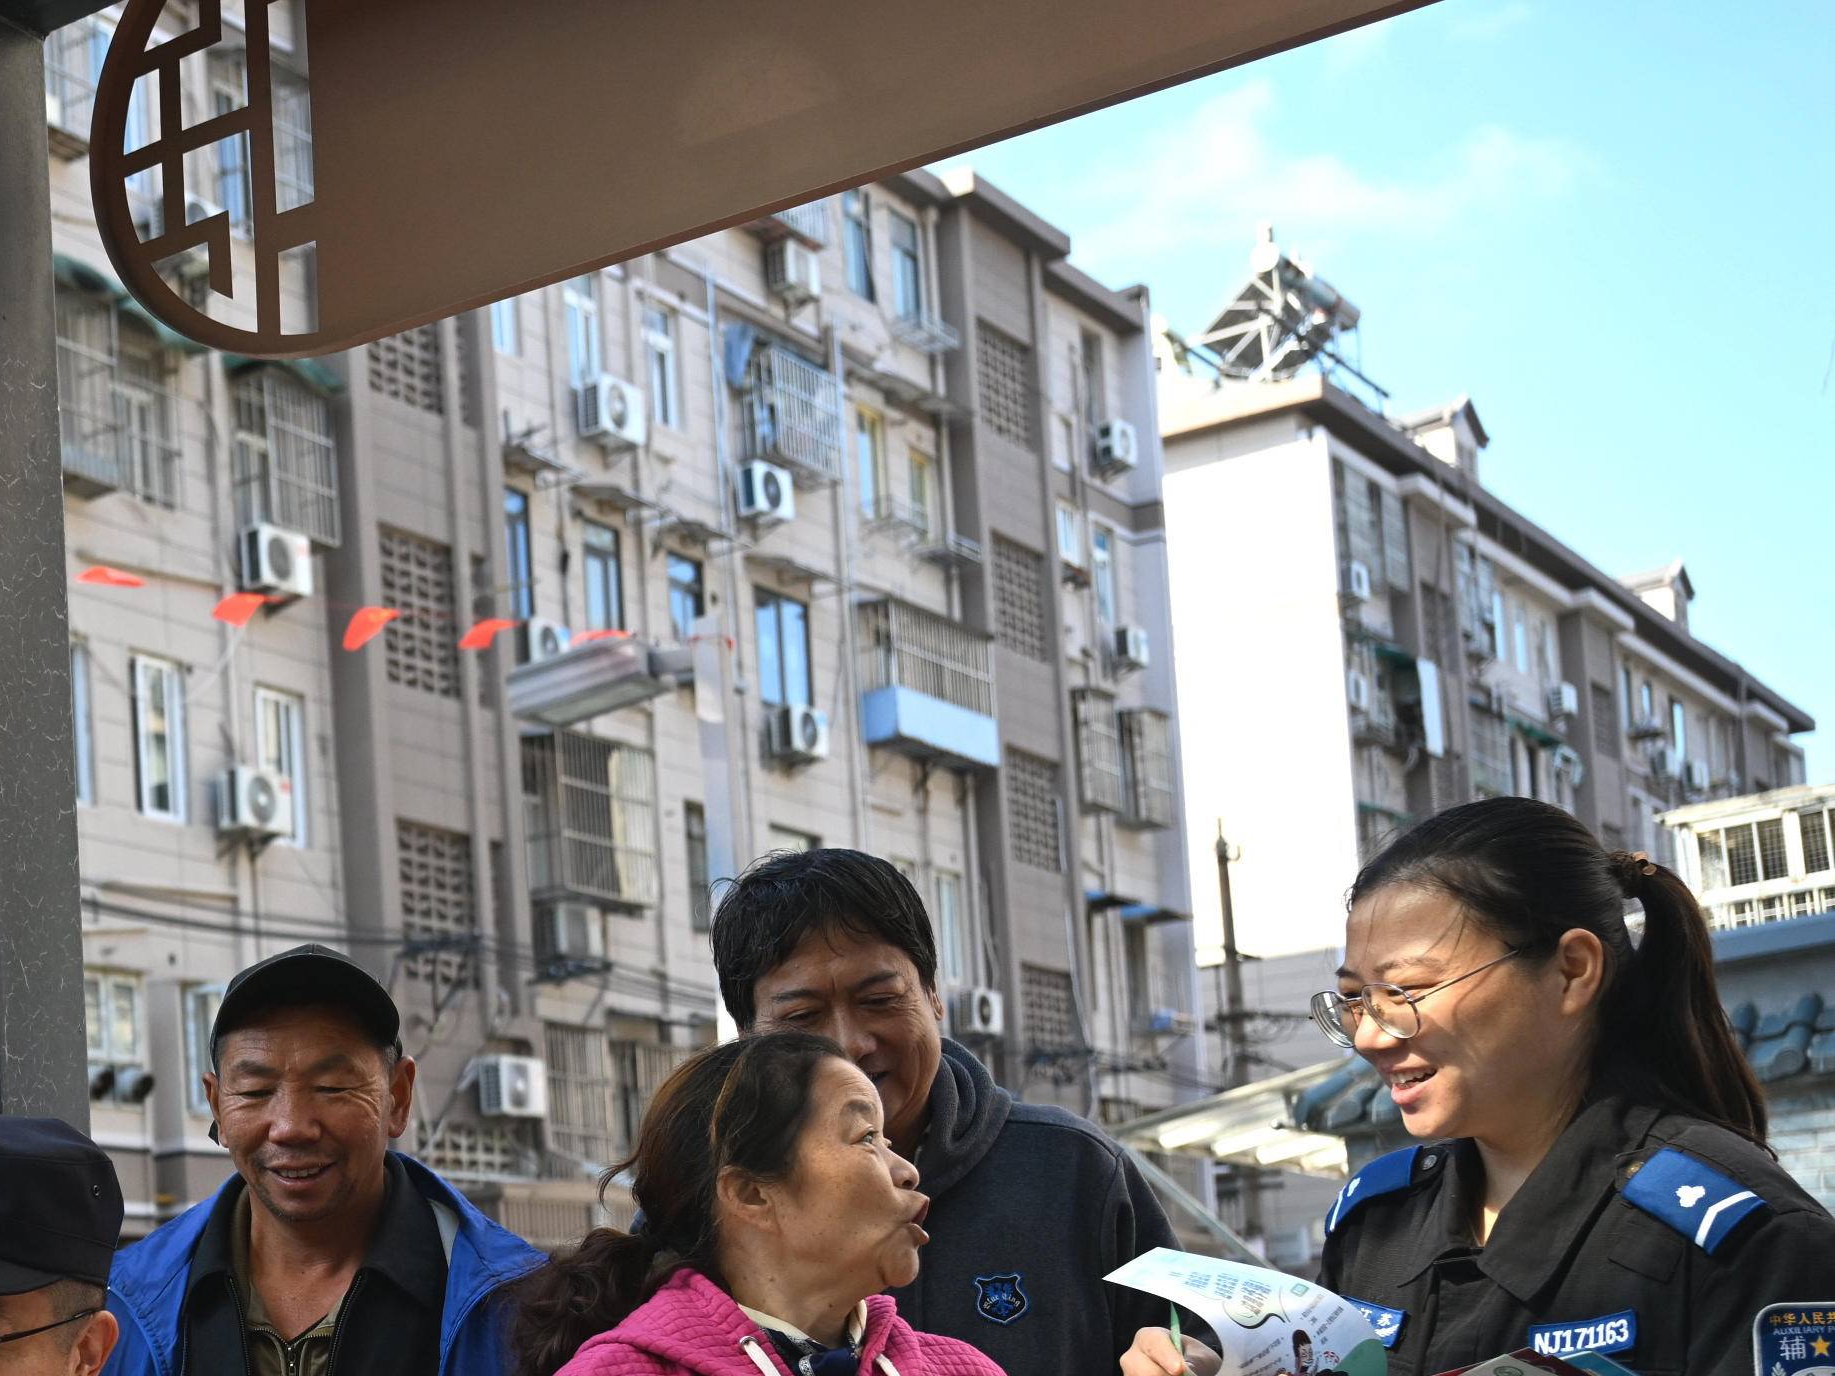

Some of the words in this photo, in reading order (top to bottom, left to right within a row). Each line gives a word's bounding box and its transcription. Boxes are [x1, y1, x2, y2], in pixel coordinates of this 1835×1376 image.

[1769, 1311, 1835, 1326] 中华人民共
[1534, 1319, 1629, 1355] NJ171163
[1773, 1326, 1825, 1336] AUXILIARY
[1778, 1335, 1807, 1361] 辅
